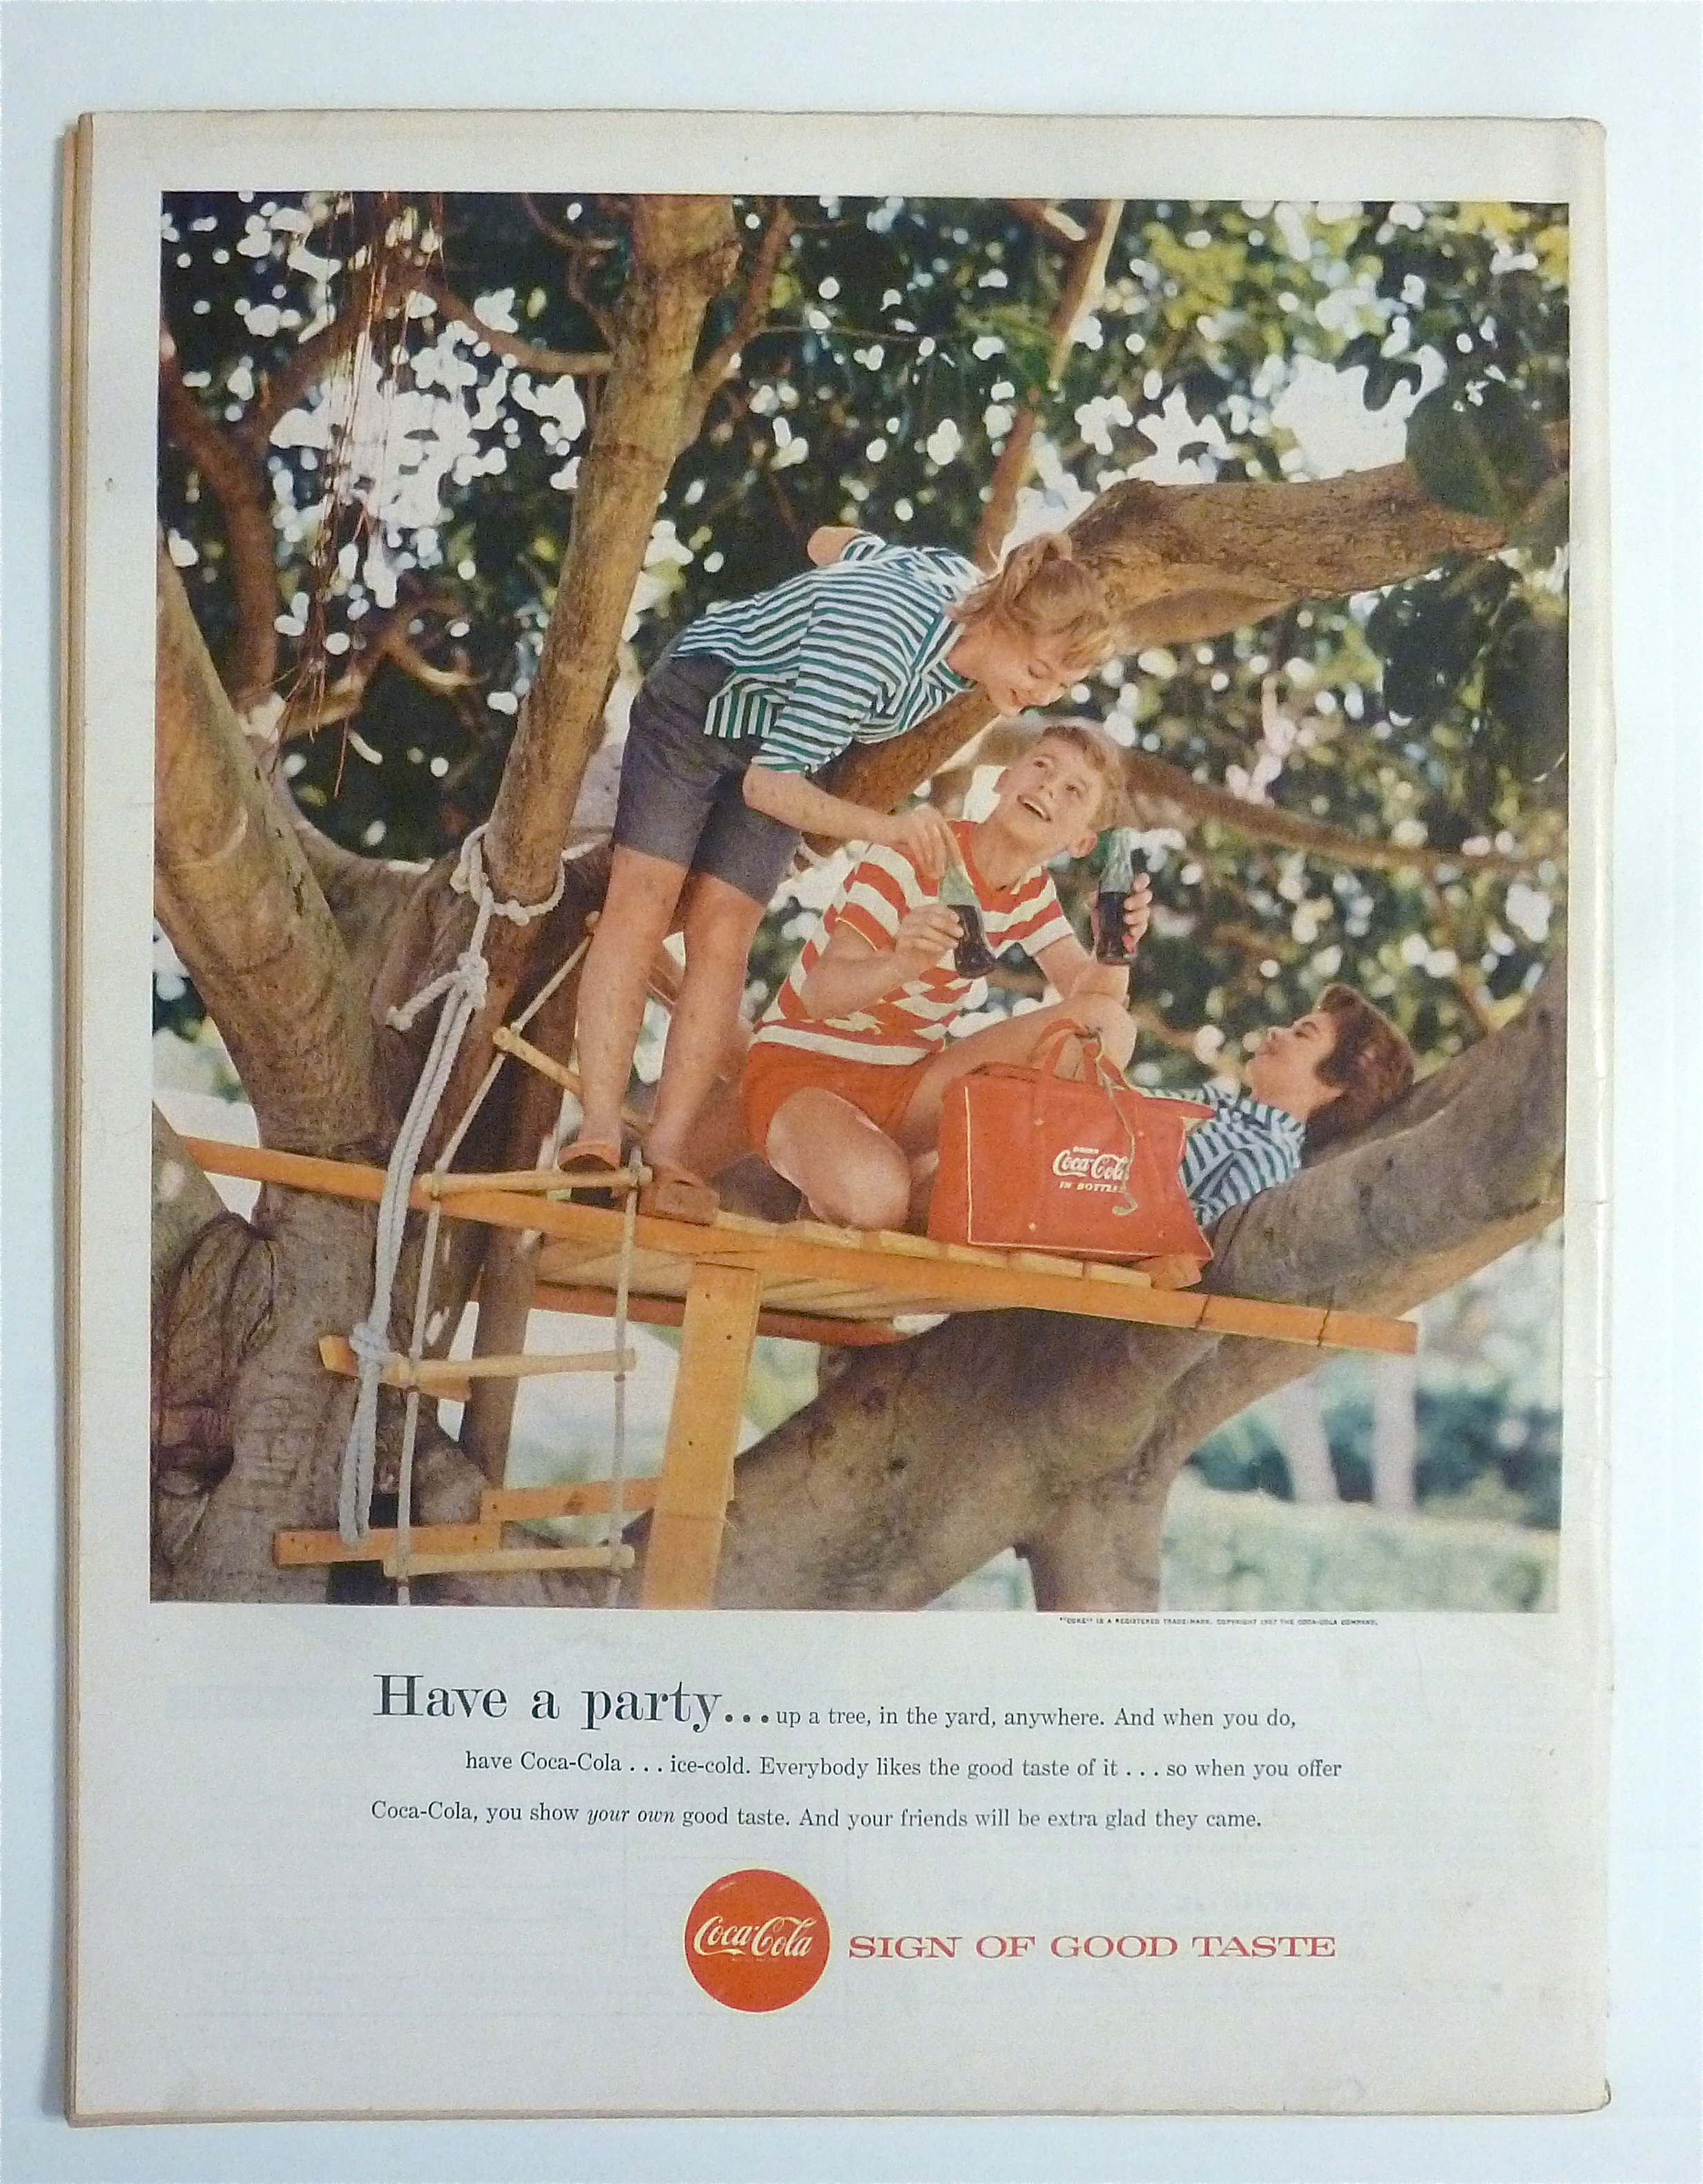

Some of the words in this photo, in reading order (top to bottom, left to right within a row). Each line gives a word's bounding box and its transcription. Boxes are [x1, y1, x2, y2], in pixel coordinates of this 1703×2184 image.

[372, 1674, 508, 1719] Have
[531, 1688, 560, 1720] a
[776, 1710, 801, 1728] up
[808, 1711, 821, 1725] a
[827, 1707, 871, 1728] tree,
[879, 1705, 898, 1725] in
[906, 1705, 938, 1726] the
[945, 1706, 996, 1729] yard,
[1004, 1707, 1105, 1730] anywhere.
[1113, 1707, 1155, 1726] And
[1162, 1708, 1214, 1726] when
[1222, 1712, 1259, 1730] you
[1267, 1708, 1296, 1729] do,
[465, 1750, 512, 1770] have
[520, 1750, 622, 1772] Coca-Cola
[670, 1754, 751, 1775] ice-cold.
[758, 1756, 869, 1780] Everybody
[876, 1757, 921, 1776] likes
[928, 1757, 960, 1776] the
[967, 1757, 1014, 1780] good
[1021, 1759, 1070, 1777] taste
[1077, 1757, 1097, 1777] of
[1103, 1758, 1119, 1777] it
[1166, 1763, 1187, 1777] so
[1194, 1758, 1246, 1777] when
[1252, 1763, 1289, 1781] you
[1298, 1758, 1343, 1777] offer
[371, 1799, 478, 1824] Coca-Cola,
[485, 1807, 523, 1824] you
[530, 1801, 579, 1821] show
[586, 1808, 631, 1826] your
[637, 1810, 675, 1824] own
[682, 1806, 729, 1828] good
[737, 1808, 790, 1826] taste.
[798, 1807, 839, 1827] And
[847, 1813, 894, 1831] your
[901, 1808, 968, 1827] friends
[974, 1808, 1010, 1827] will
[1017, 1808, 1041, 1827] be
[1047, 1810, 1098, 1827] extra
[1105, 1808, 1146, 1831] glad
[1155, 1808, 1199, 1831] they
[1206, 1814, 1262, 1828] came.
[693, 1915, 817, 1957] Coca-Cola
[848, 1935, 963, 1960] SIGN
[975, 1935, 1036, 1959] OF
[1050, 1935, 1178, 1959] GOOD
[1191, 1935, 1336, 1958] TASTE
